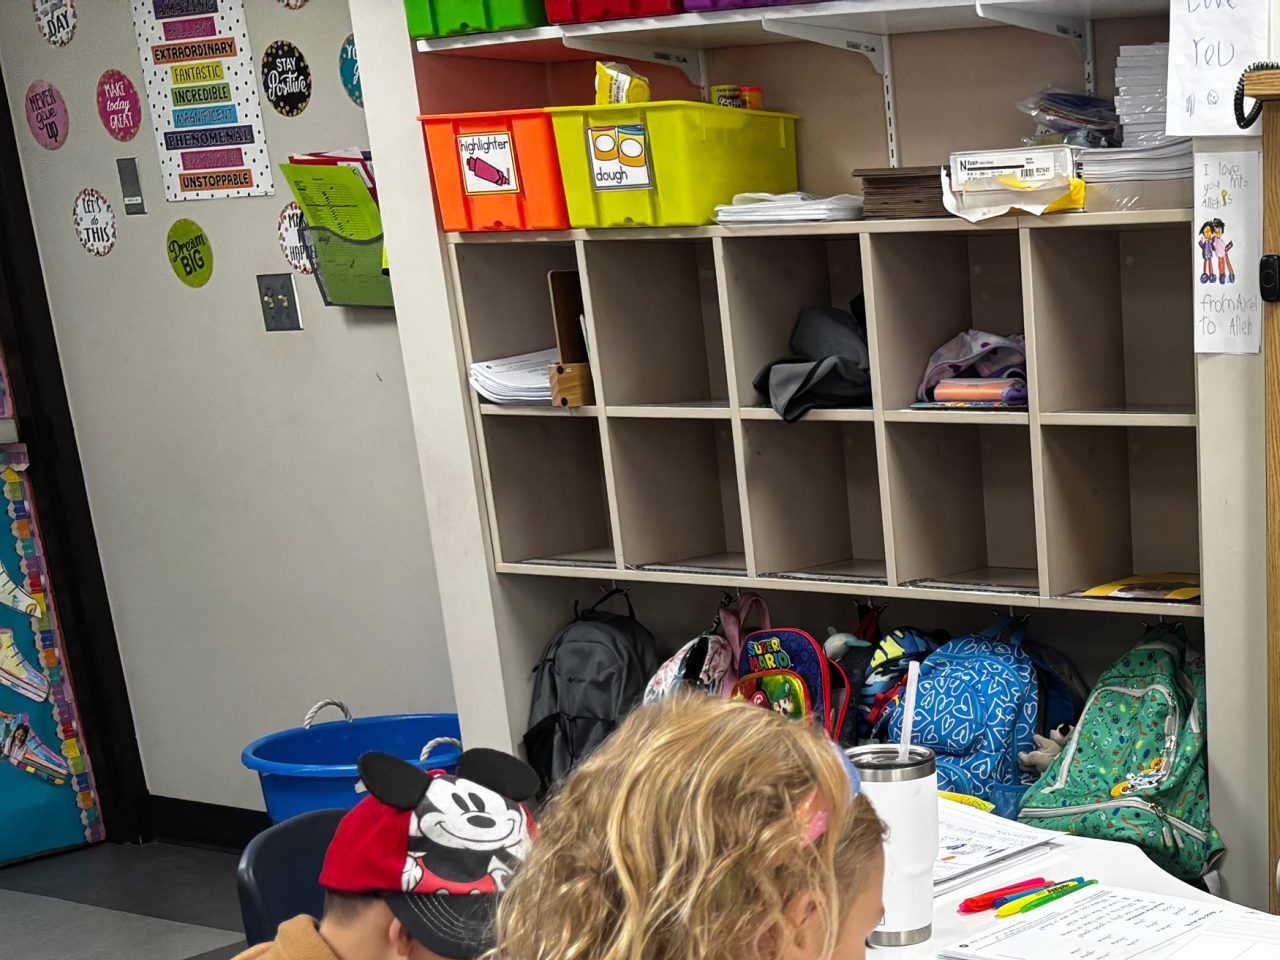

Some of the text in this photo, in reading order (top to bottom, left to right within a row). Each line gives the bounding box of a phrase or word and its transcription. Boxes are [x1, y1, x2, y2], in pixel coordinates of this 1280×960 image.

[47, 10, 70, 38] DAY
[154, 41, 234, 61] EXTRAORDINARY
[174, 65, 221, 81] FANTASTIC
[276, 57, 296, 72] STAY
[104, 81, 126, 98] MAKE
[268, 69, 307, 100] Positive
[28, 88, 57, 112] NEVER
[174, 86, 229, 103] INCREDIBLE
[106, 99, 130, 113] today
[35, 107, 57, 130] give
[109, 112, 133, 130] GREAT
[176, 107, 233, 125] MAGNIFICENT
[167, 128, 251, 148] PHENOMENAL
[460, 135, 508, 155] highlighter
[596, 166, 628, 184] dough
[1203, 161, 1240, 177] I love
[182, 172, 249, 189] UNSTOPPABLE
[83, 199, 102, 214] LET'S
[90, 215, 99, 226] do
[84, 227, 110, 243] THIS
[168, 234, 205, 263] Dream
[181, 249, 205, 276] BIG
[749, 637, 780, 653] SUPER
[750, 651, 789, 671] MARIO
